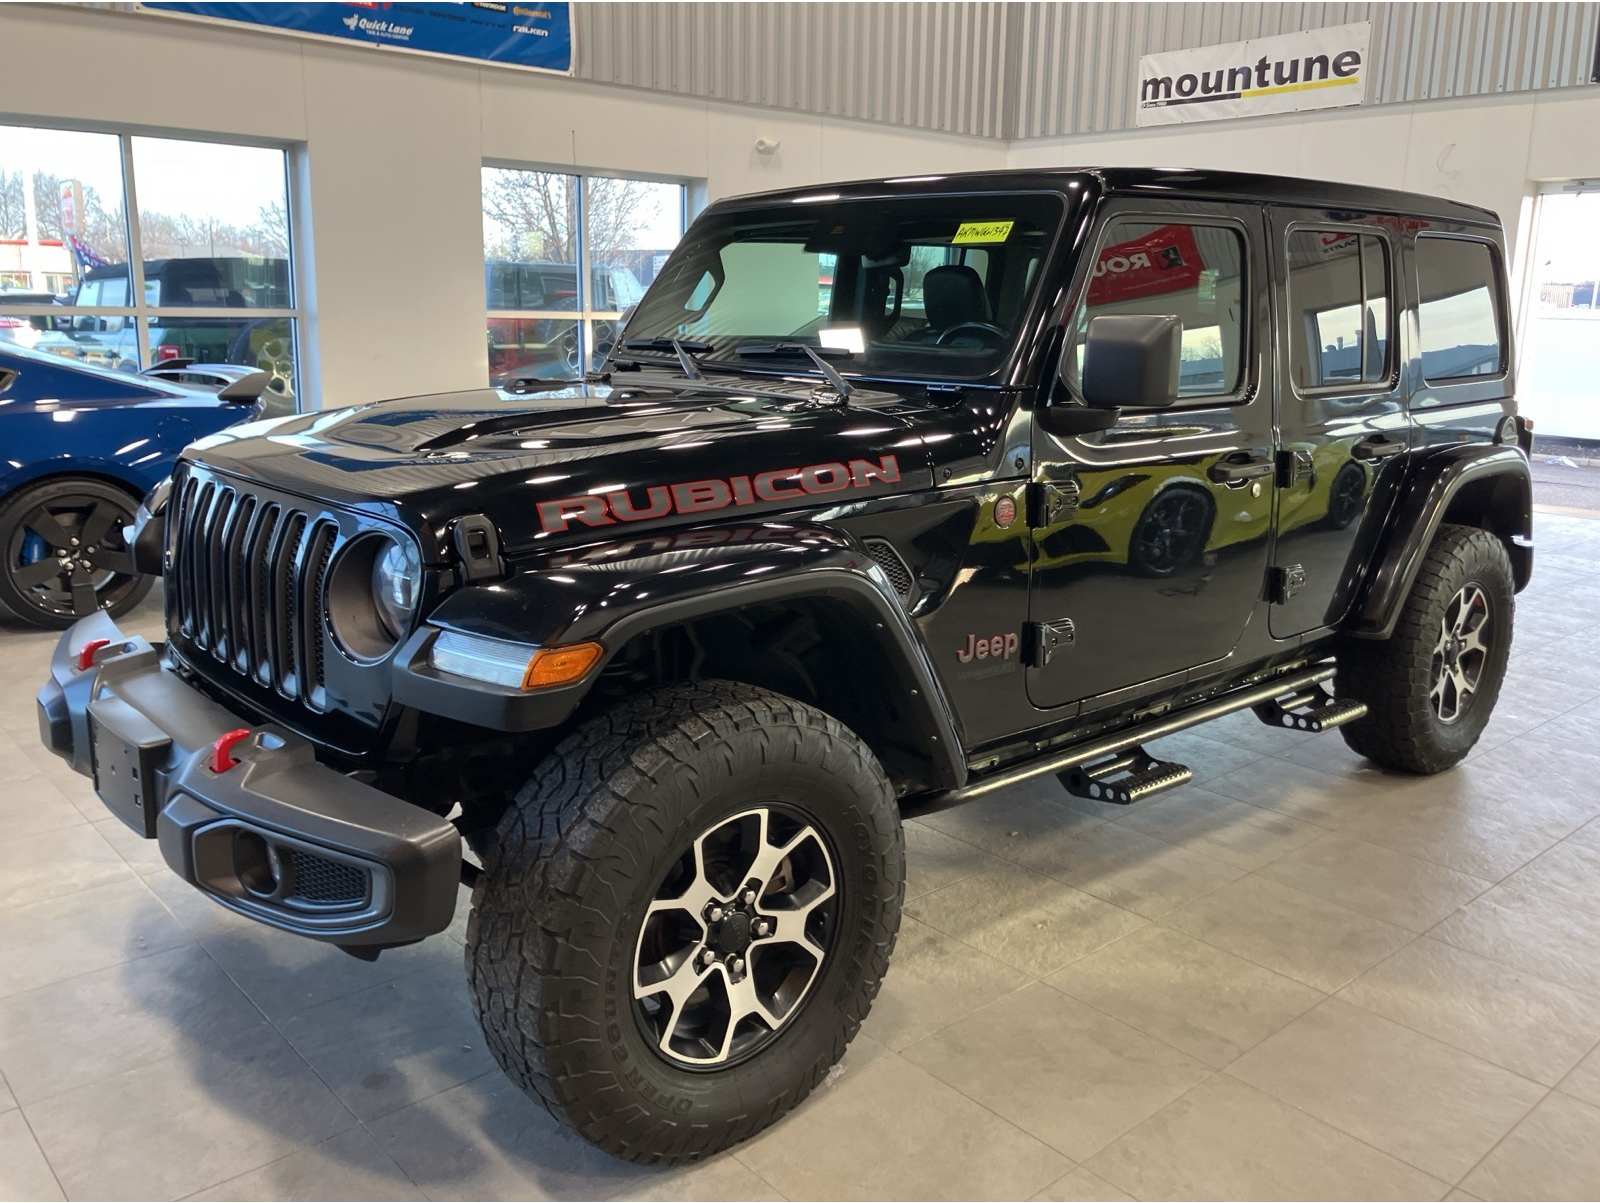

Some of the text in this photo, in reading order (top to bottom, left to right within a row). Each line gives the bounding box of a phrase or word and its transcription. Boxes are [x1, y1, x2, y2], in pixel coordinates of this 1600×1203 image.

[358, 17, 387, 31] Quick
[387, 23, 414, 36] Lane
[1141, 50, 1361, 100] mountune
[535, 454, 901, 534] RUBICON
[956, 632, 1018, 663] Jeep
